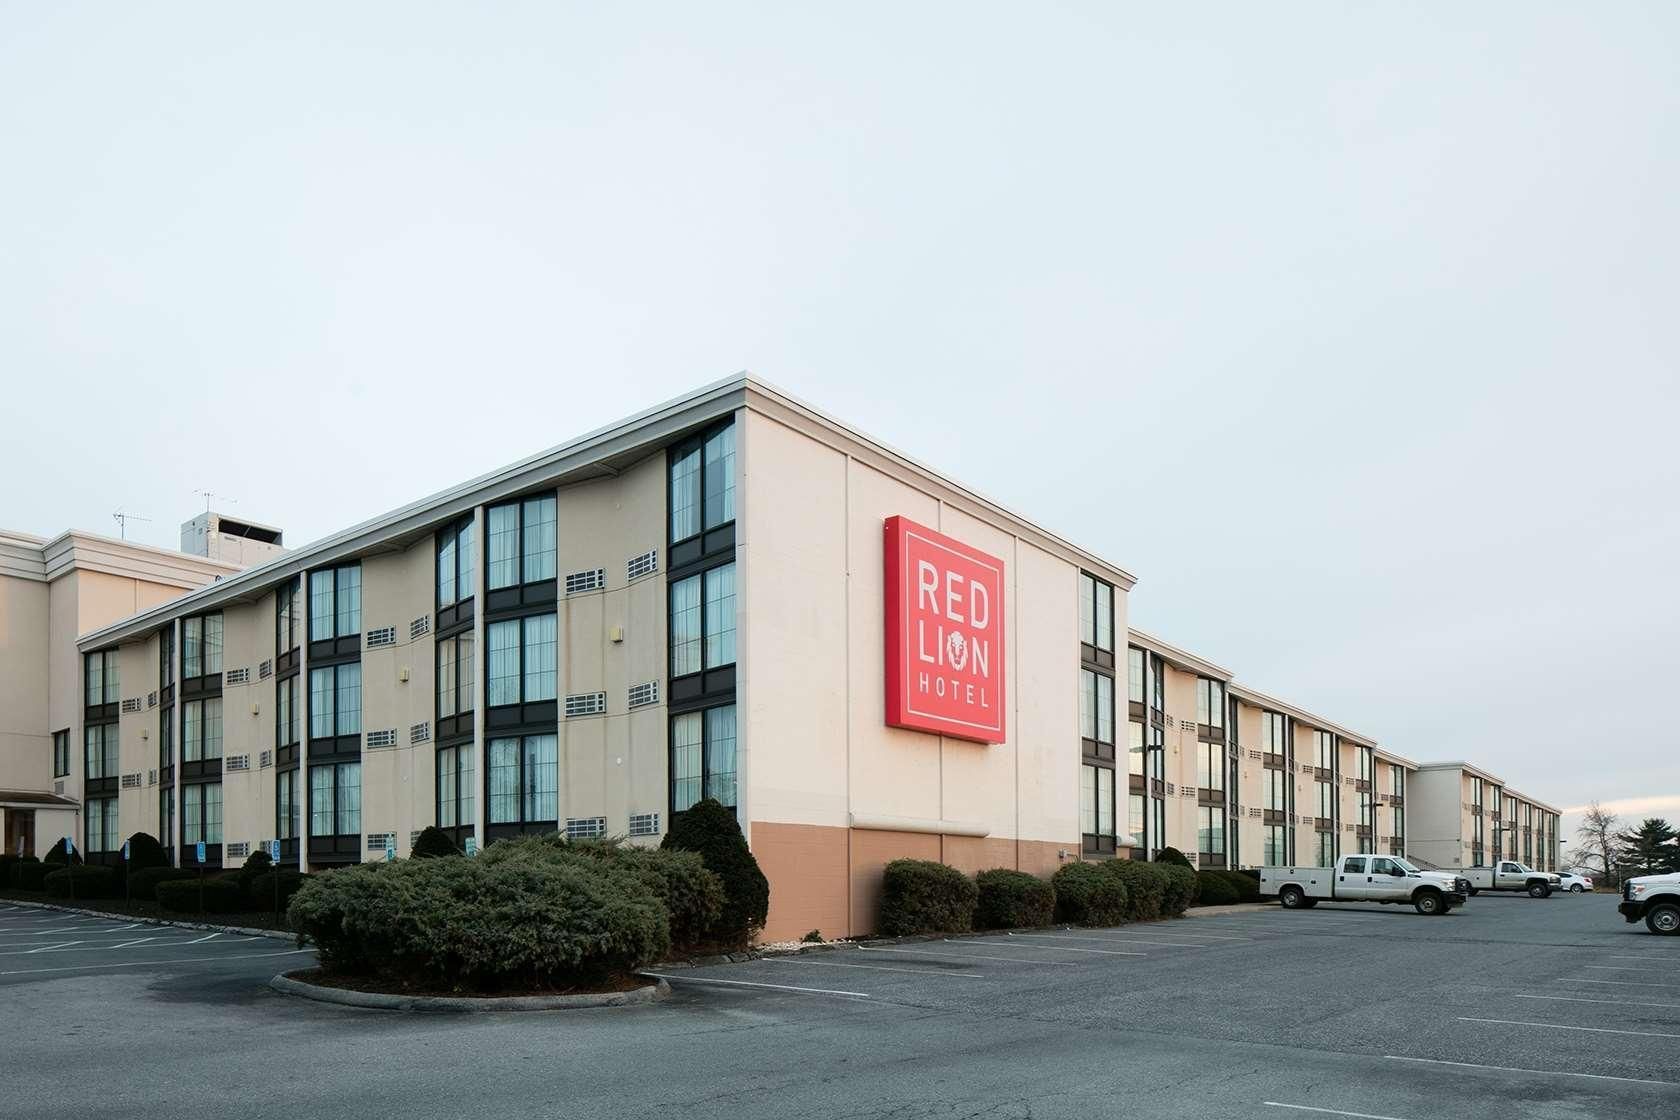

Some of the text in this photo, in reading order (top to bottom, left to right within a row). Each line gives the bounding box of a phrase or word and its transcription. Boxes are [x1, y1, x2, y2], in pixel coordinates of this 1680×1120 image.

[918, 560, 990, 630] RED
[918, 619, 989, 679] LION
[919, 671, 989, 708] HOTEL
